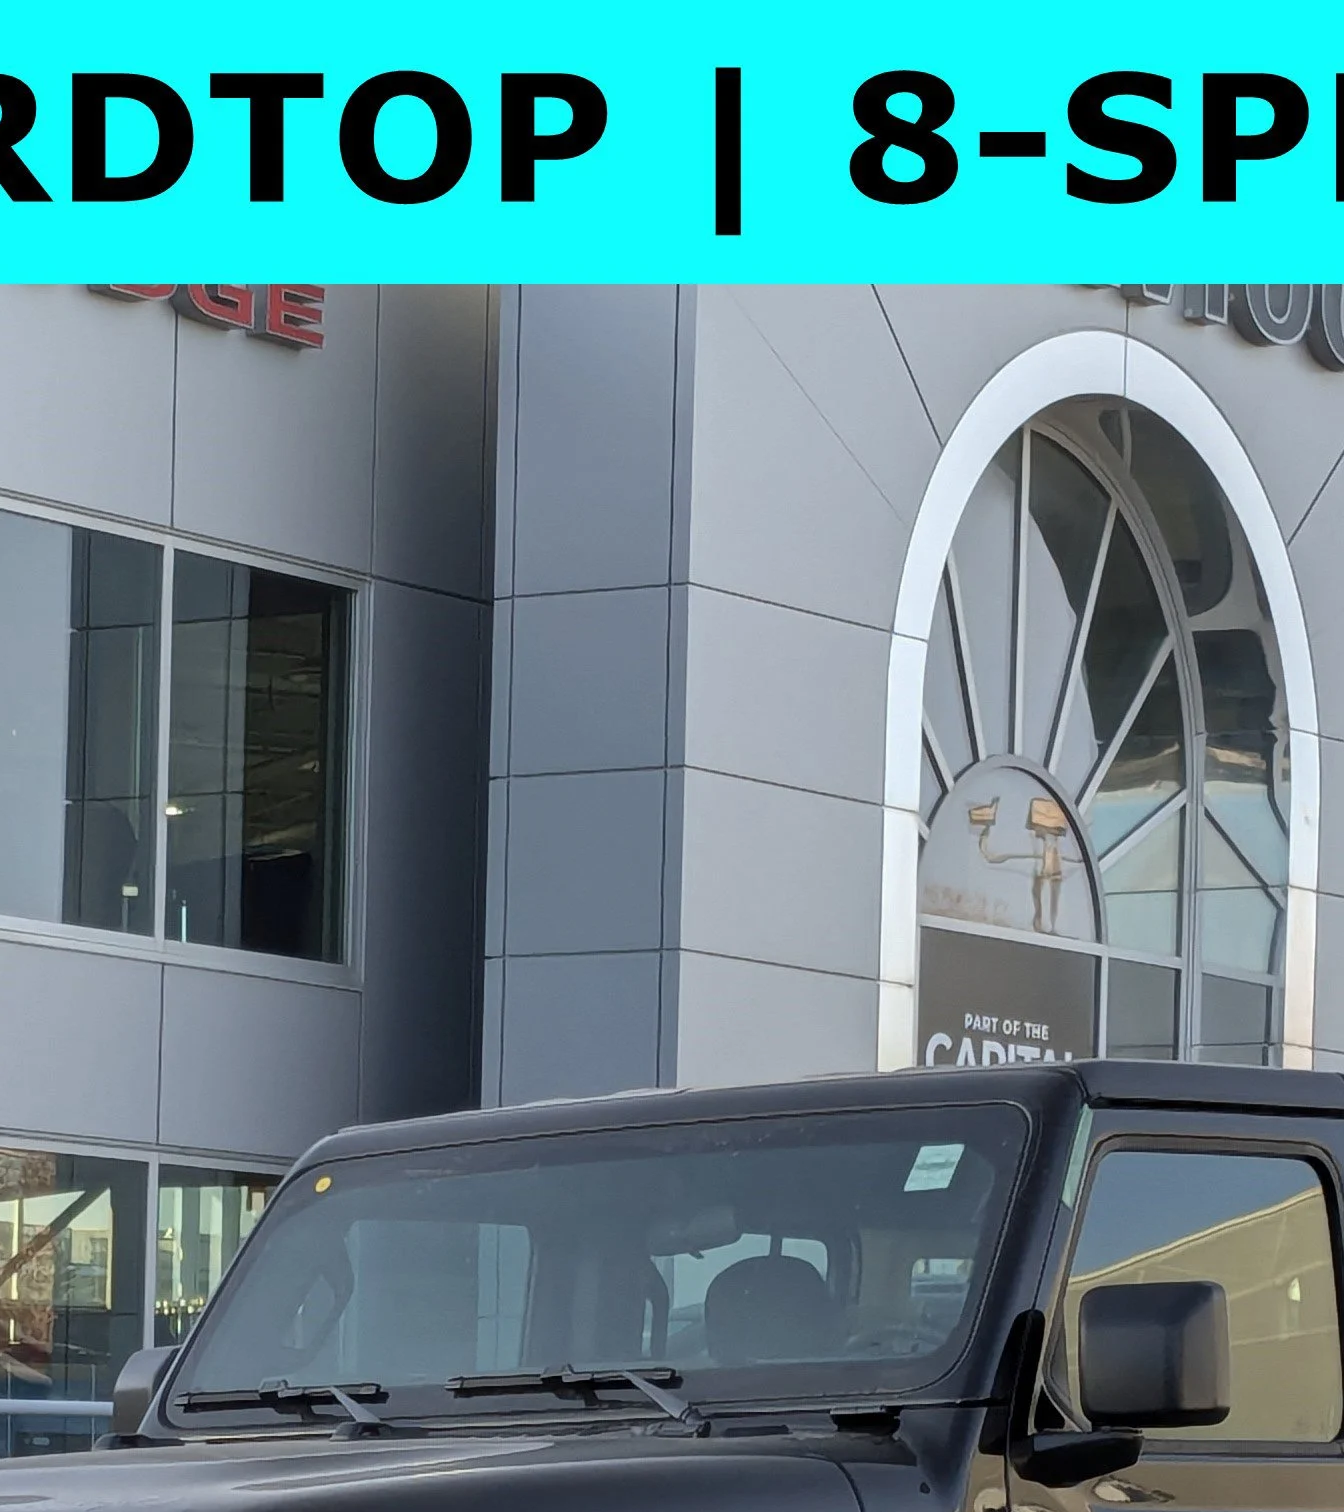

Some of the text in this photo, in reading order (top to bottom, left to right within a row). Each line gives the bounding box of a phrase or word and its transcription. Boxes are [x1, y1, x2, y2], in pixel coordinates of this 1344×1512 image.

[964, 1012, 1050, 1041] PART OF THE
